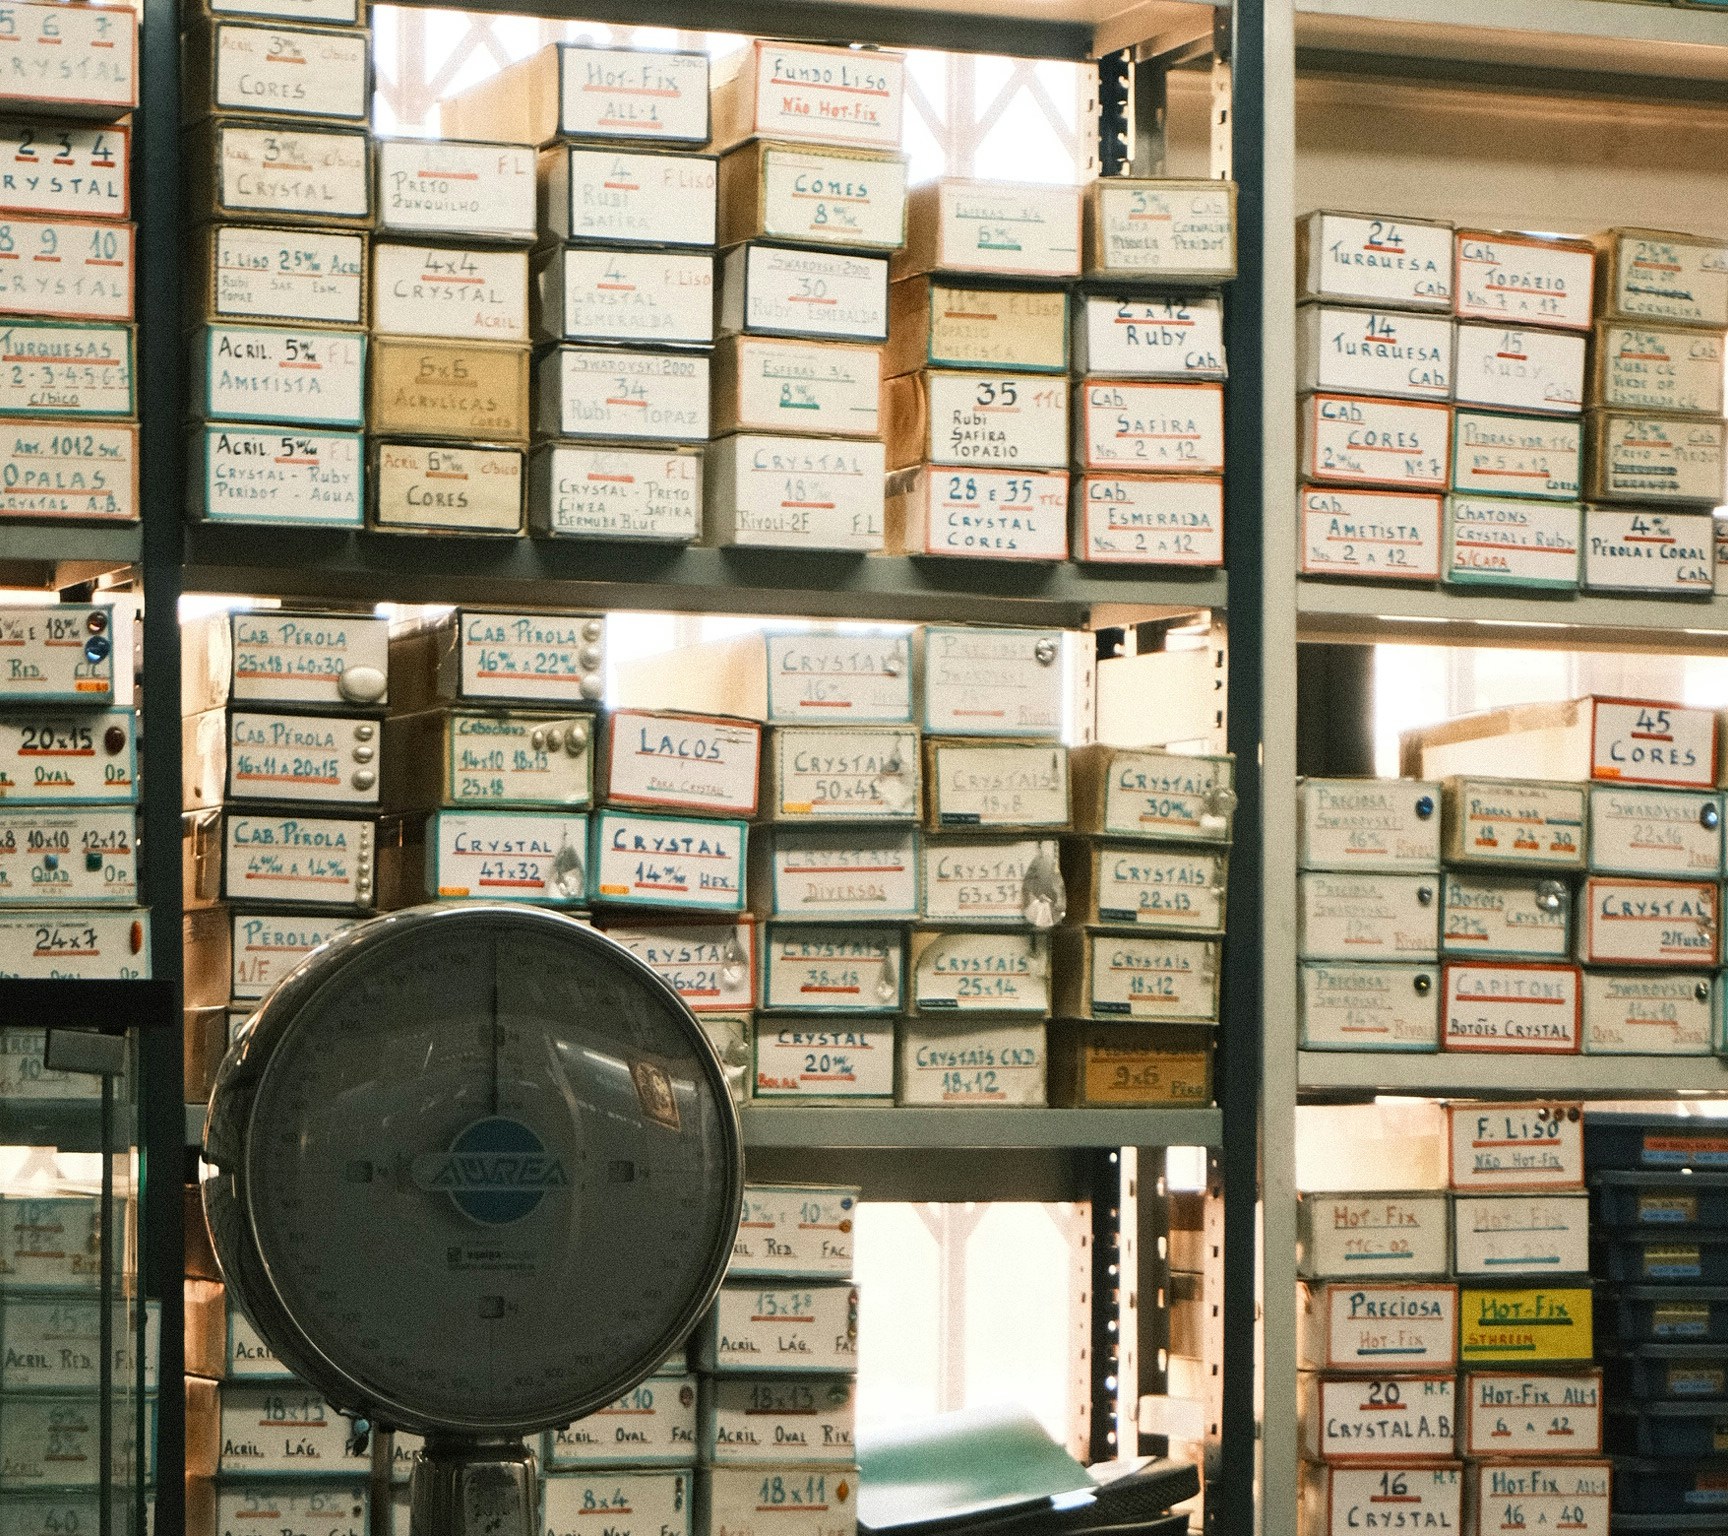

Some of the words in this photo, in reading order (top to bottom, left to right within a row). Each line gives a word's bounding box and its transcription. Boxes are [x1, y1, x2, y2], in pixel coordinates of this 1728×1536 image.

[42, 15, 61, 36] 6
[92, 135, 113, 162] 4
[1368, 221, 1404, 245] 24
[91, 232, 117, 258] 10
[1366, 315, 1396, 336] 14
[977, 383, 1017, 406] 35
[950, 478, 977, 500] 28
[1004, 480, 1033, 503] 35
[1635, 710, 1670, 731] 45
[1369, 1382, 1400, 1404] 20
[1380, 1472, 1408, 1495] 16
[1504, 1504, 1524, 1524] 16
[1562, 1507, 1584, 1523] 40
